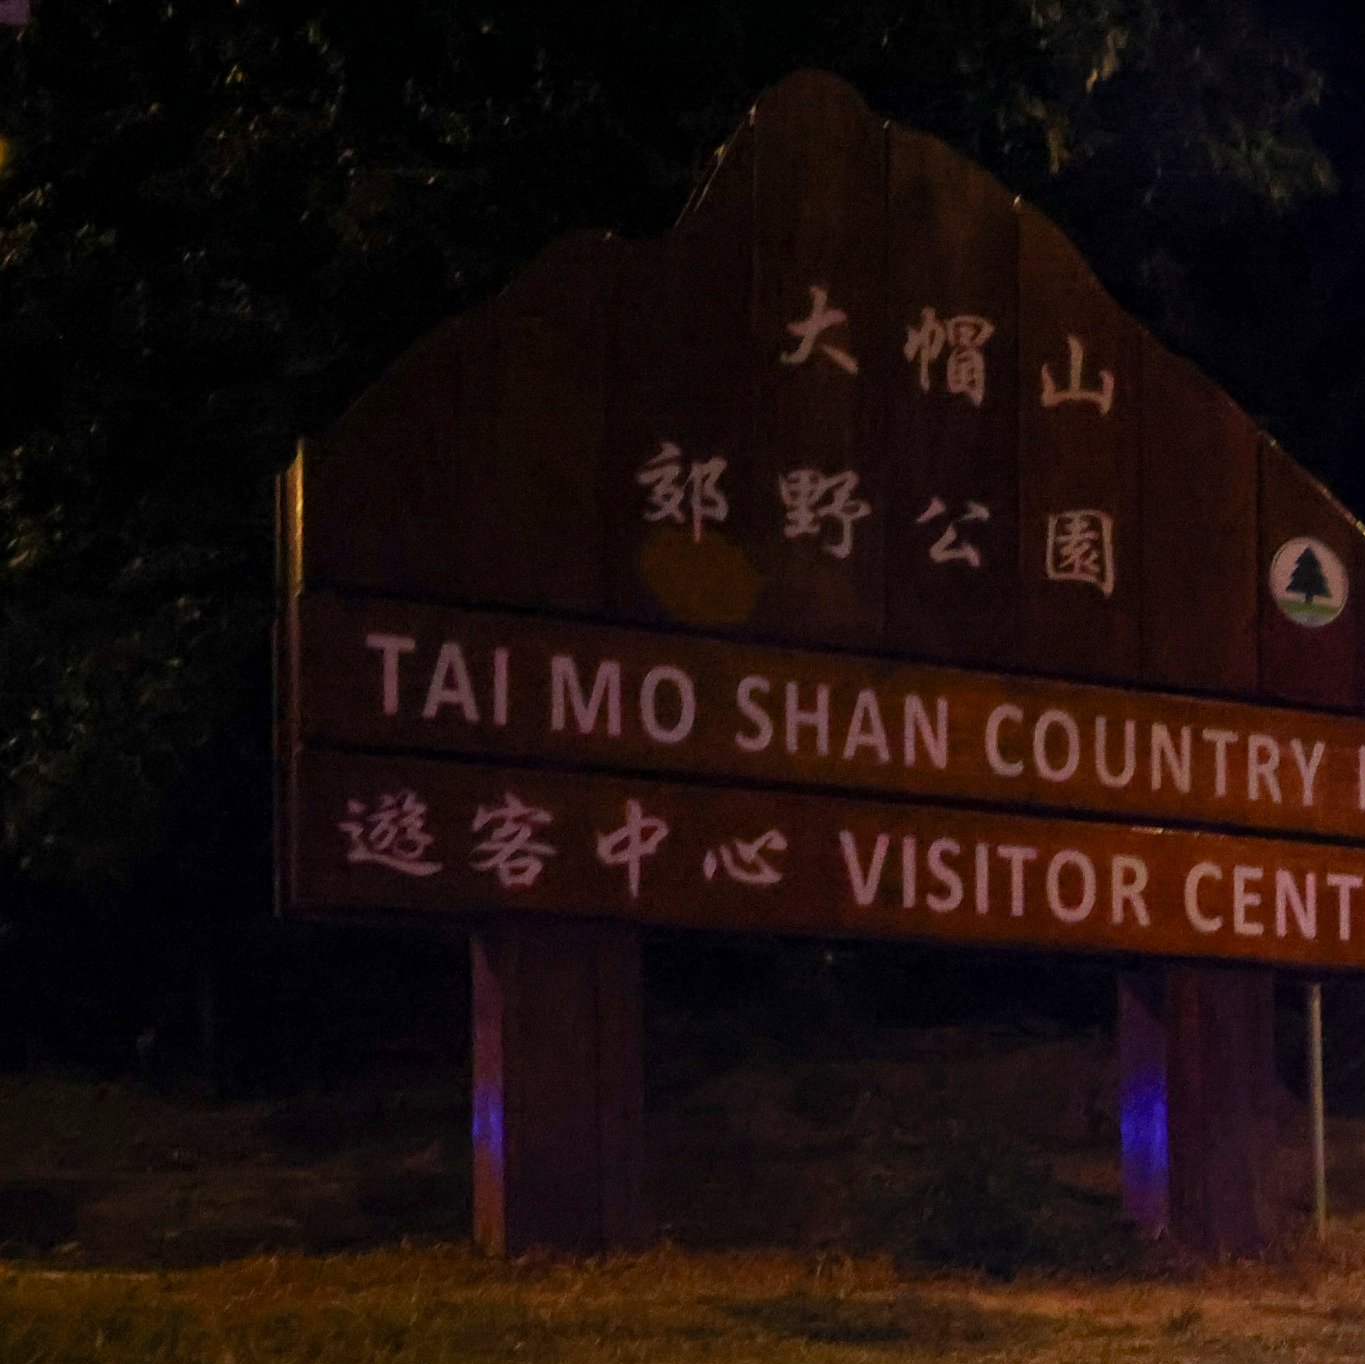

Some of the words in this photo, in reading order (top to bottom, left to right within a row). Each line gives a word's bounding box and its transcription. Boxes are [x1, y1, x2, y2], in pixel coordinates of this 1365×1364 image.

[782, 287, 1115, 413] 大帽山
[638, 443, 1116, 596] 郊野公園
[366, 634, 509, 726] TAI
[551, 656, 696, 744] MO
[735, 676, 949, 768] SHAN
[985, 705, 1326, 807] COUNTRY
[341, 792, 788, 897] 遊客中心
[839, 830, 1150, 927] VISITOR
